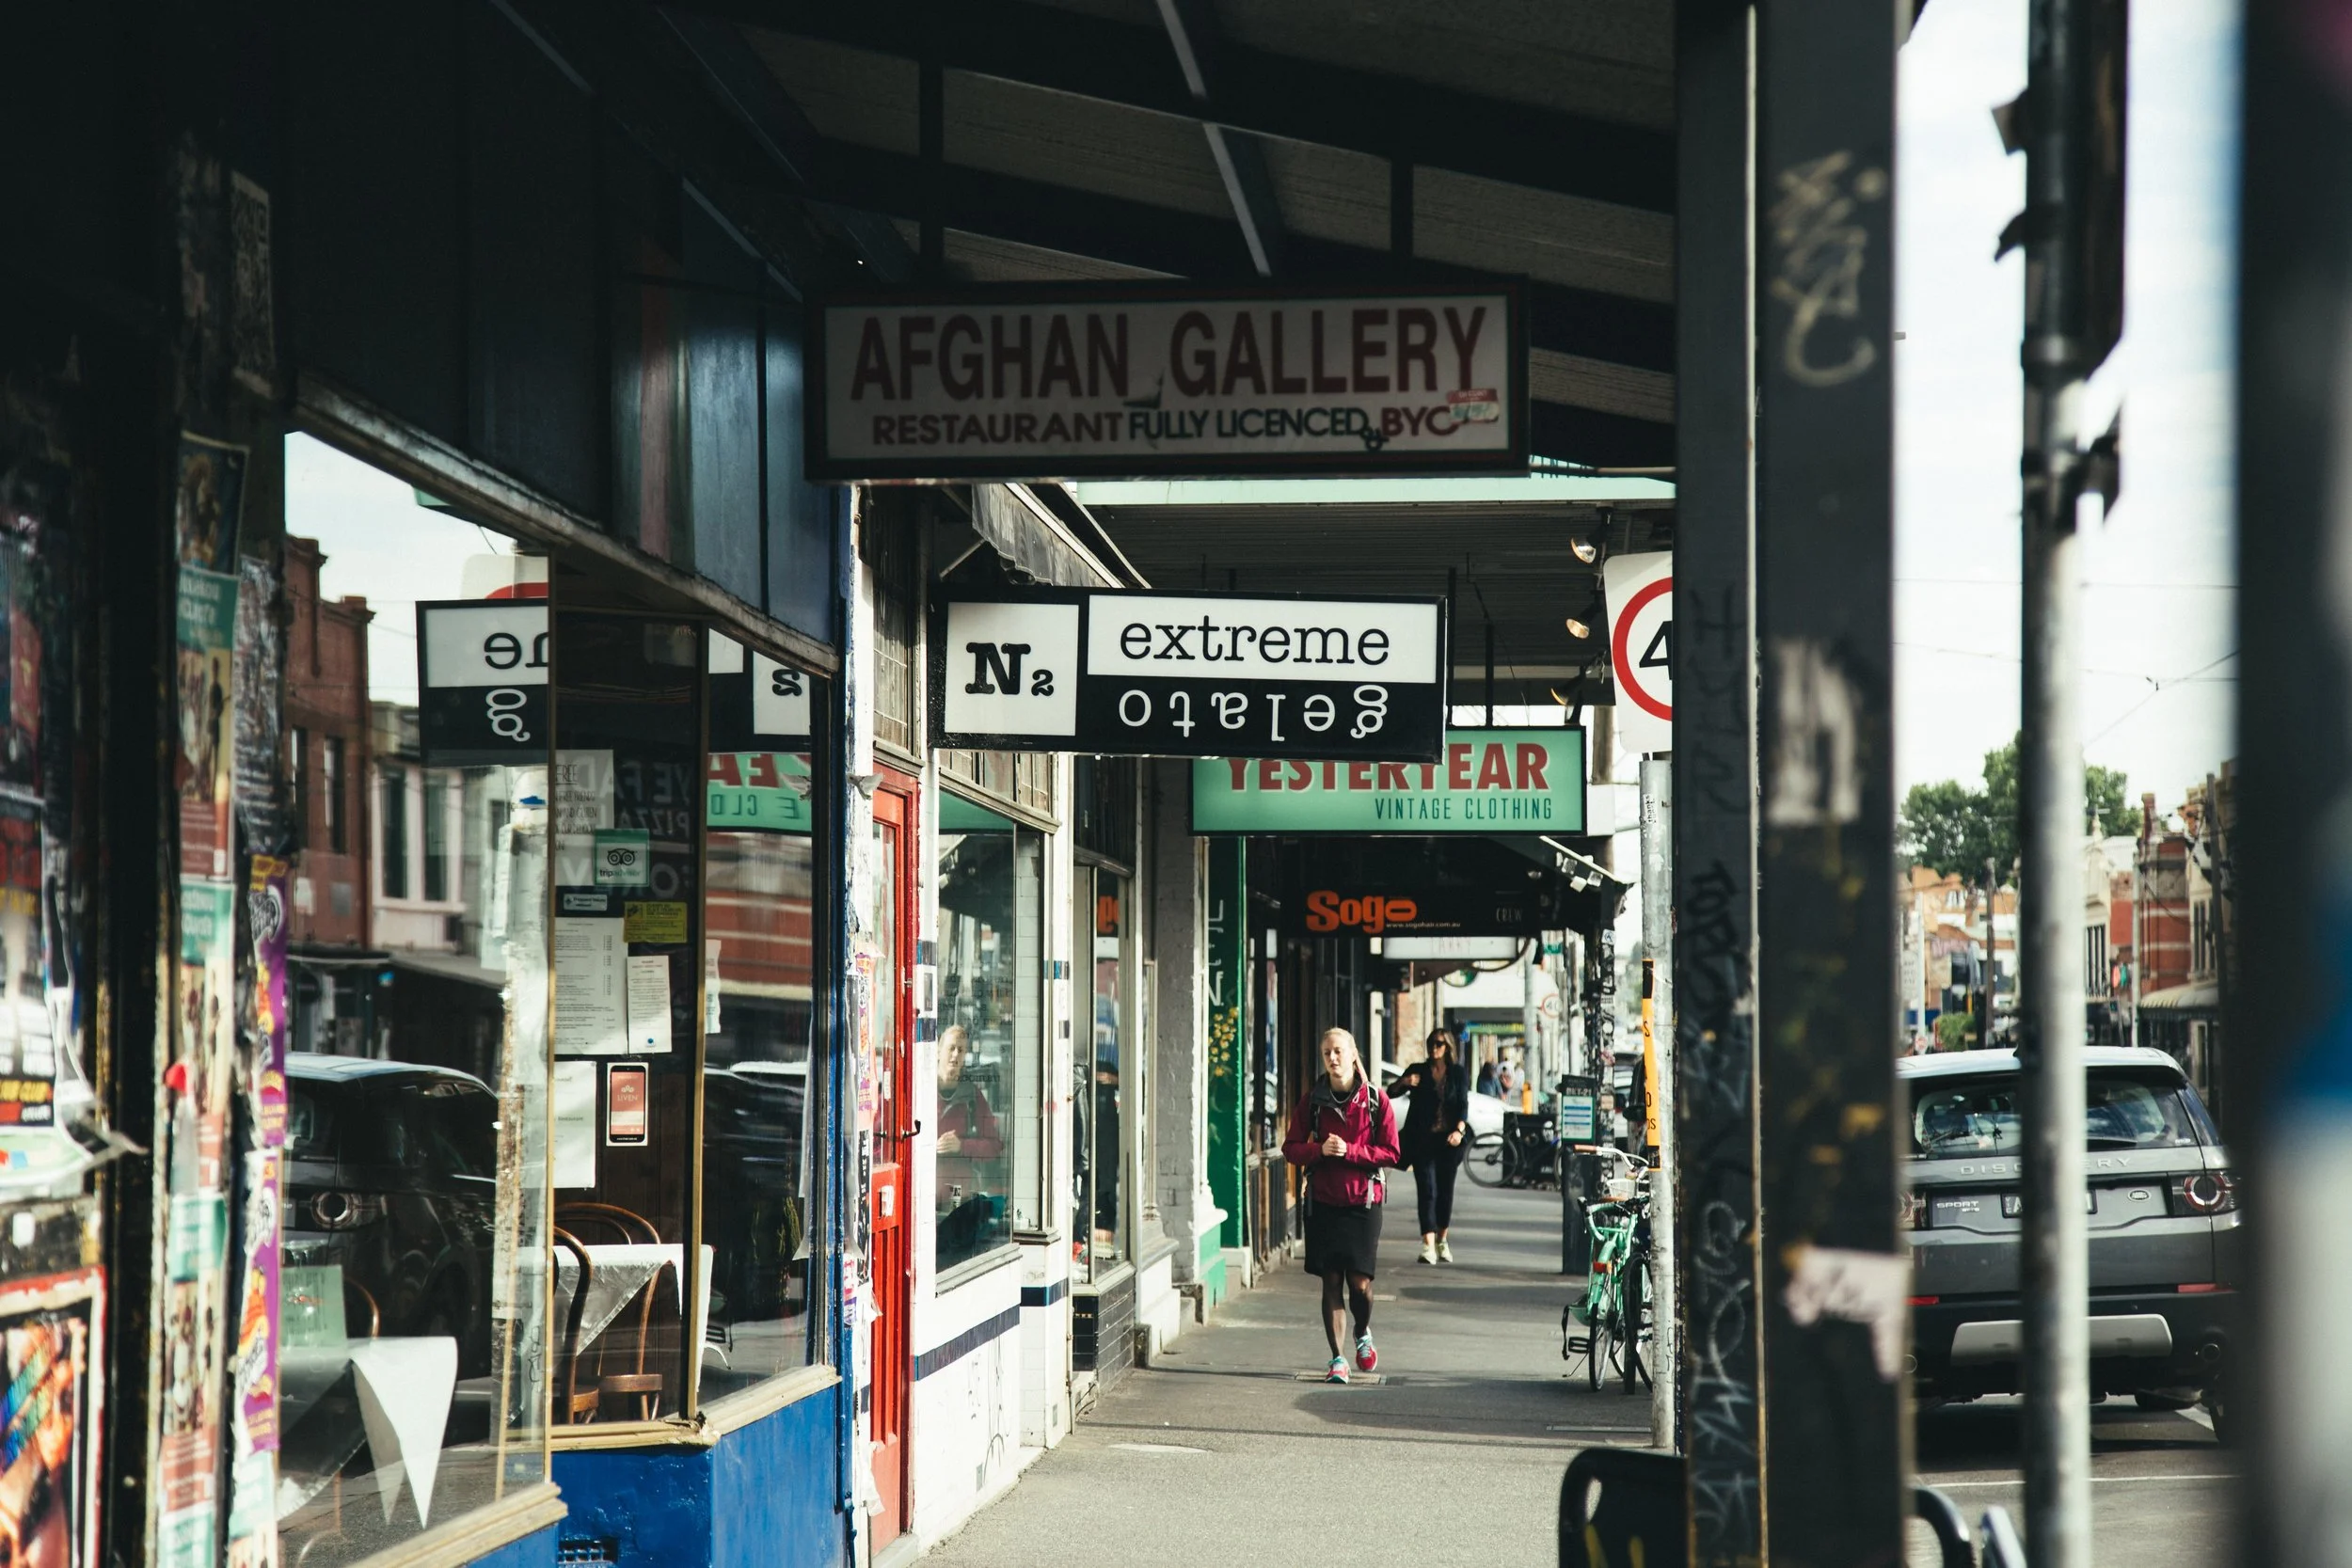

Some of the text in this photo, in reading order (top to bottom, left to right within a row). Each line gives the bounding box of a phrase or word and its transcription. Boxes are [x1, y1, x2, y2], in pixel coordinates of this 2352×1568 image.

[850, 306, 1486, 402] AFGHAN GALLERY
[872, 410, 1126, 446] RESTAURANT
[1129, 407, 1206, 440] FULLY
[1216, 405, 1369, 439] LICENCED
[1120, 615, 1390, 666] extreme
[1639, 620, 1674, 681] 4
[1120, 684, 1390, 741] gelato
[1226, 742, 1550, 793] YESTERYEAR
[1375, 798, 1552, 820] VINTAGE CLOTHING
[1305, 890, 1418, 934] Sogo
[1936, 1200, 1980, 1210] SPORT
